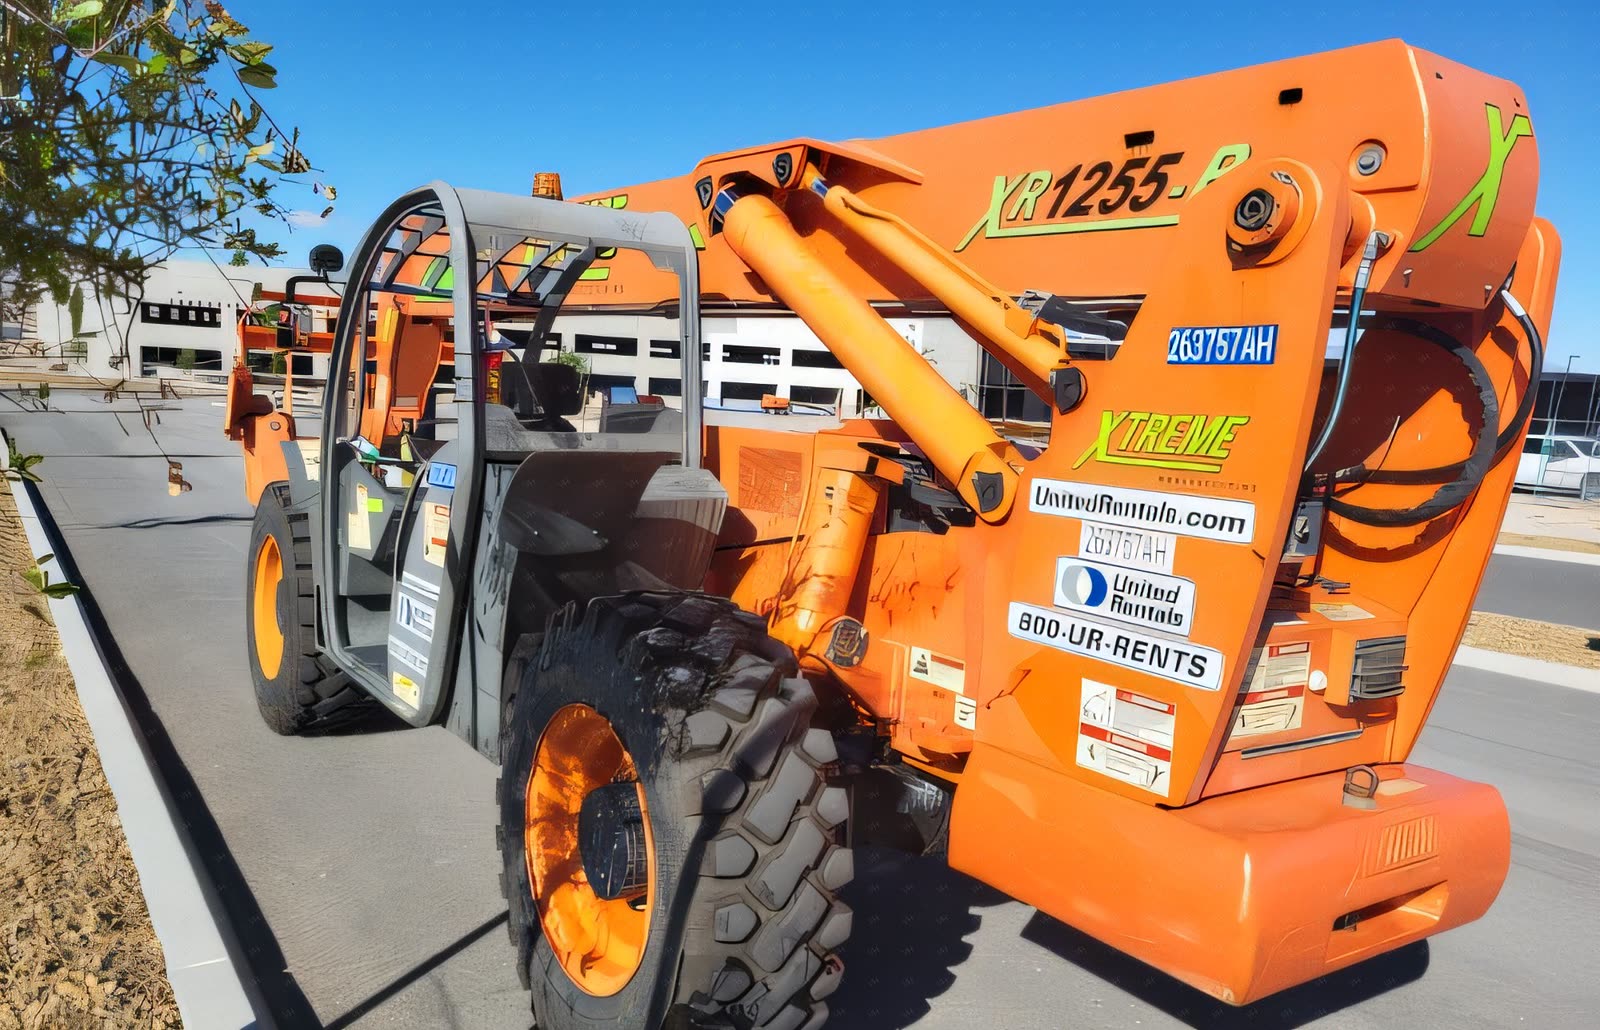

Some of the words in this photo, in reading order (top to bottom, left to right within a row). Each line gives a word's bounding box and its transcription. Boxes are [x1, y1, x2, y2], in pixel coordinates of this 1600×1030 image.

[1072, 410, 1251, 473] XTREME
[1113, 573, 1182, 604] United
[1110, 594, 1183, 627] Rentals
